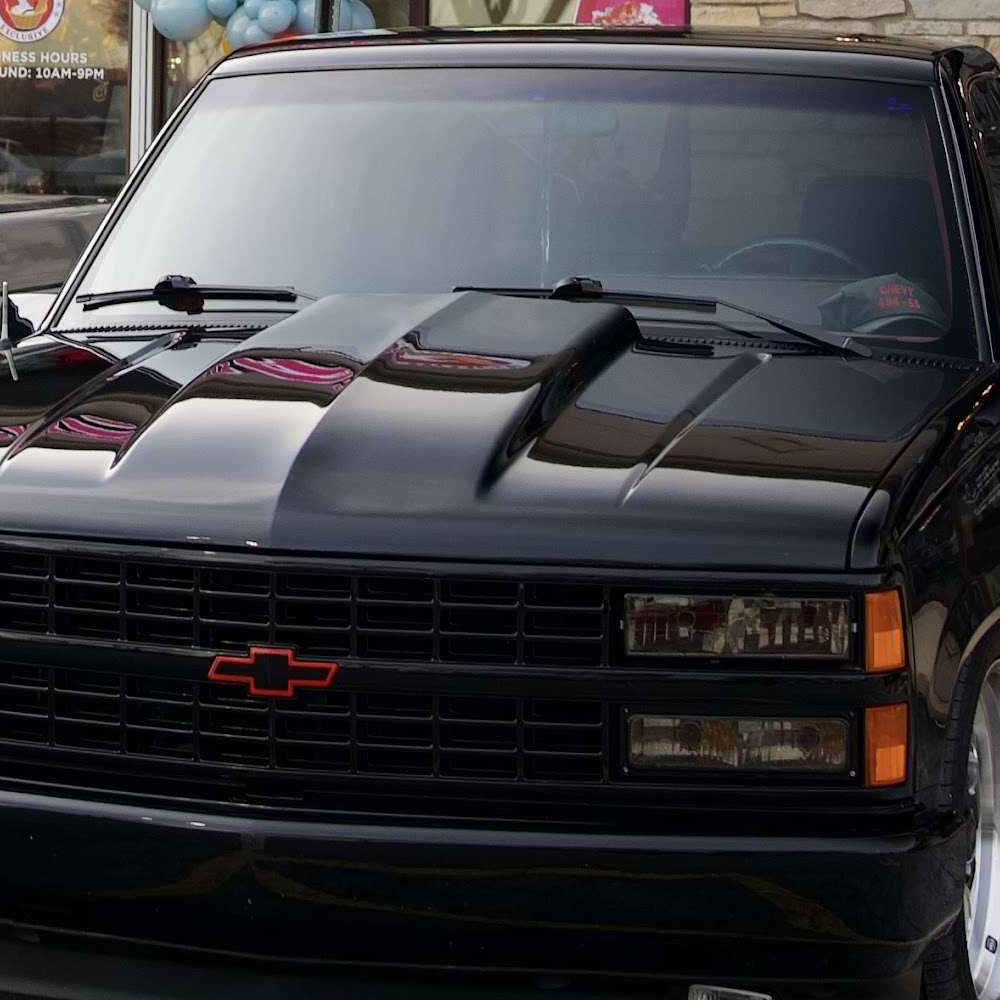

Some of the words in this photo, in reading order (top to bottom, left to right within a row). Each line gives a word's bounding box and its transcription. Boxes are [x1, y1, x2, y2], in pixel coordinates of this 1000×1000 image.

[0, 24, 48, 40] EXCLUSIVE
[40, 51, 88, 64] HOURS
[35, 67, 105, 80] 10AM-9PM
[878, 284, 915, 297] CHEVY
